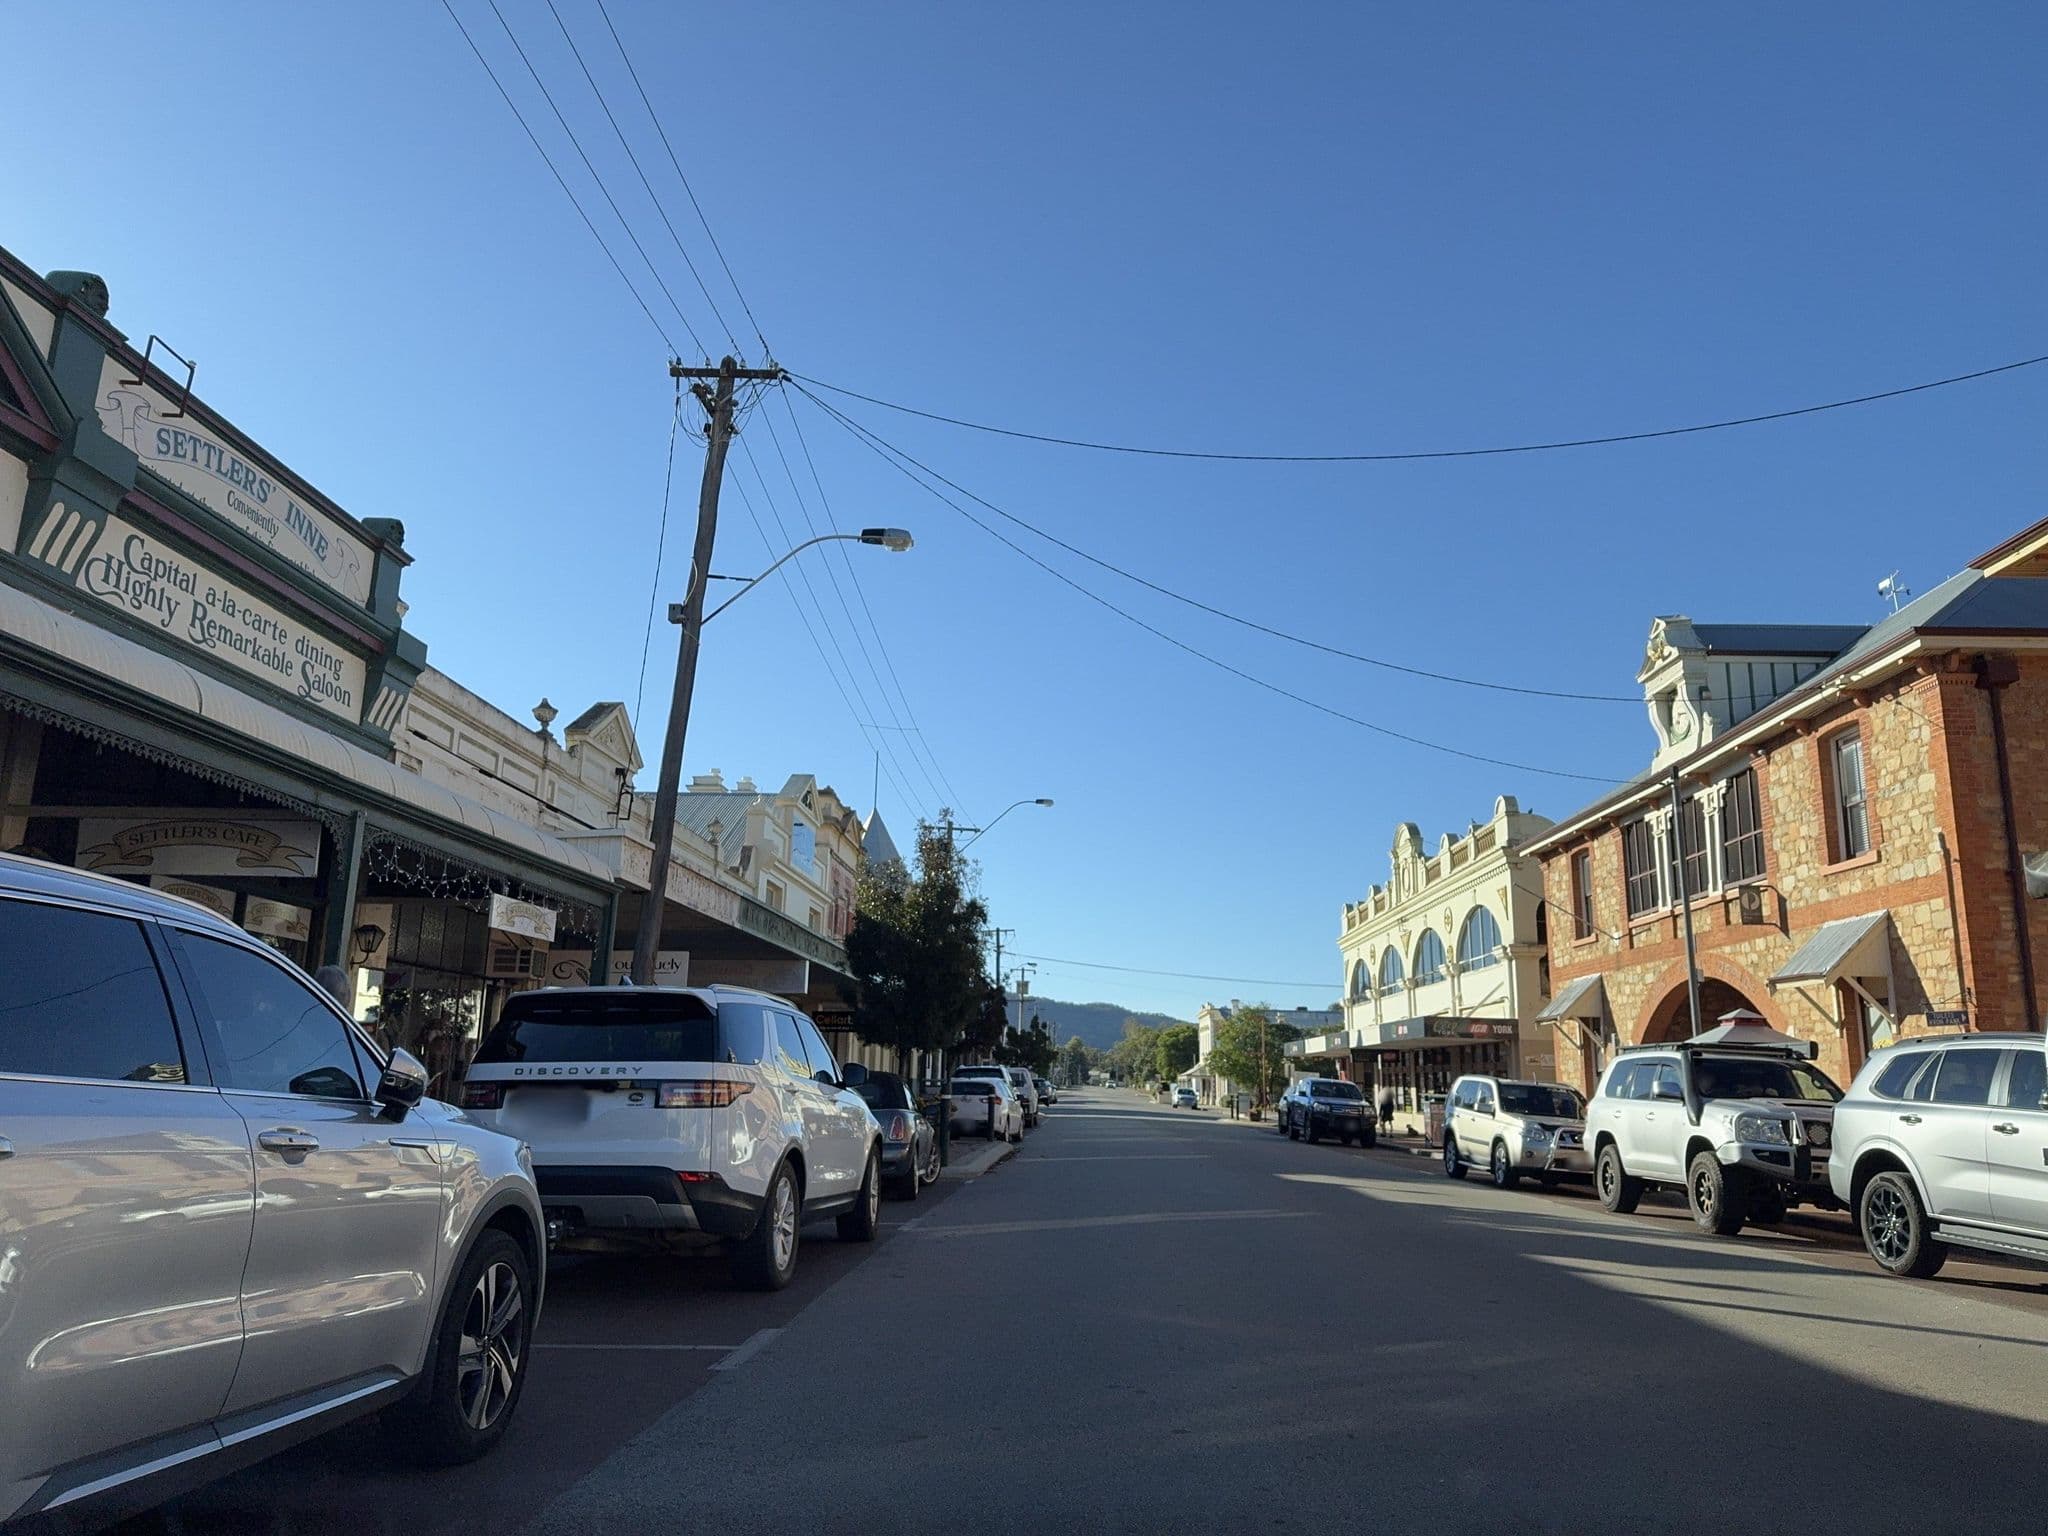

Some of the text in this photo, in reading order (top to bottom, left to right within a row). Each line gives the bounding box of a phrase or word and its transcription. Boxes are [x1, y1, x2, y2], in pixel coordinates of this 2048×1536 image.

[156, 427, 277, 504] SETTLERS'
[284, 501, 329, 562] INNE
[227, 490, 279, 539] Conveniently
[85, 552, 352, 708] Highly Remarkable Saloon
[124, 534, 344, 681] Capital a-la-carte dining
[128, 826, 266, 847] SETTLER'S CAFE
[1492, 1025, 1513, 1034] YORK
[514, 1066, 643, 1076] DISCOVERY
